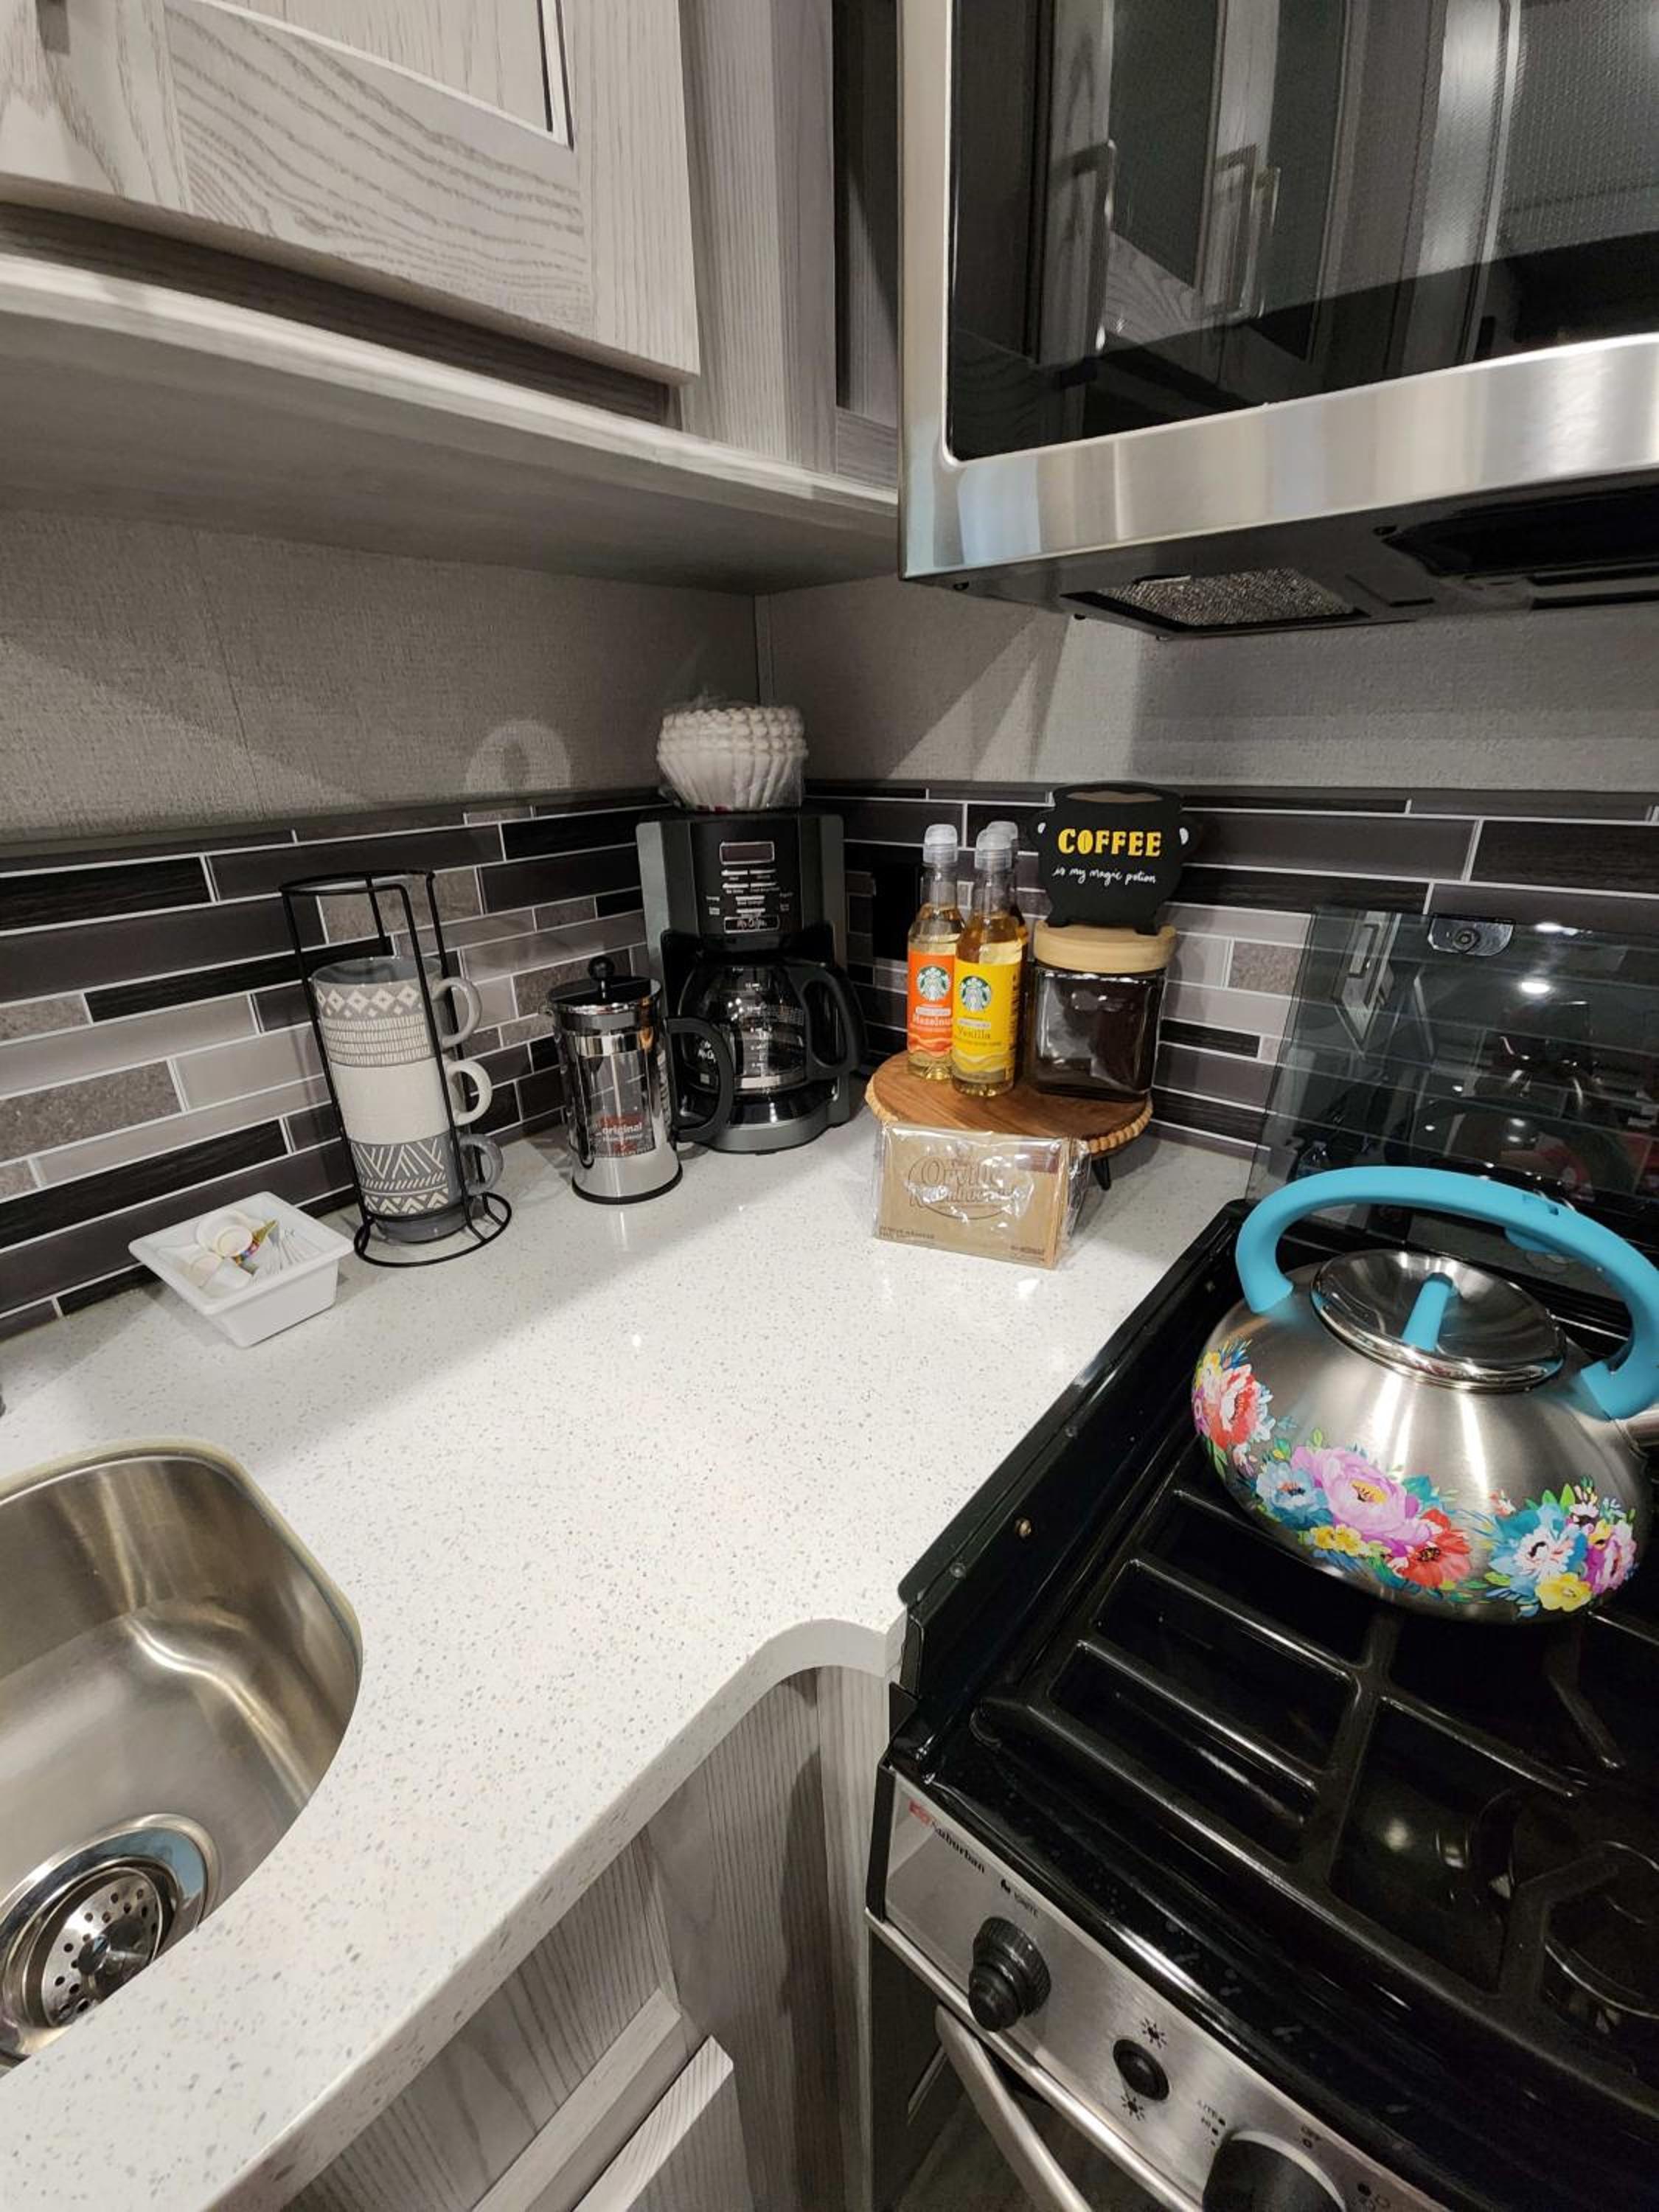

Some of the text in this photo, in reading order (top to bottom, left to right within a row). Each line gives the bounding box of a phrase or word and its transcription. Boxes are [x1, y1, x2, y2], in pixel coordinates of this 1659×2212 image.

[1057, 827, 1162, 858] COFFEE
[1052, 865, 1157, 886] is my magic potion
